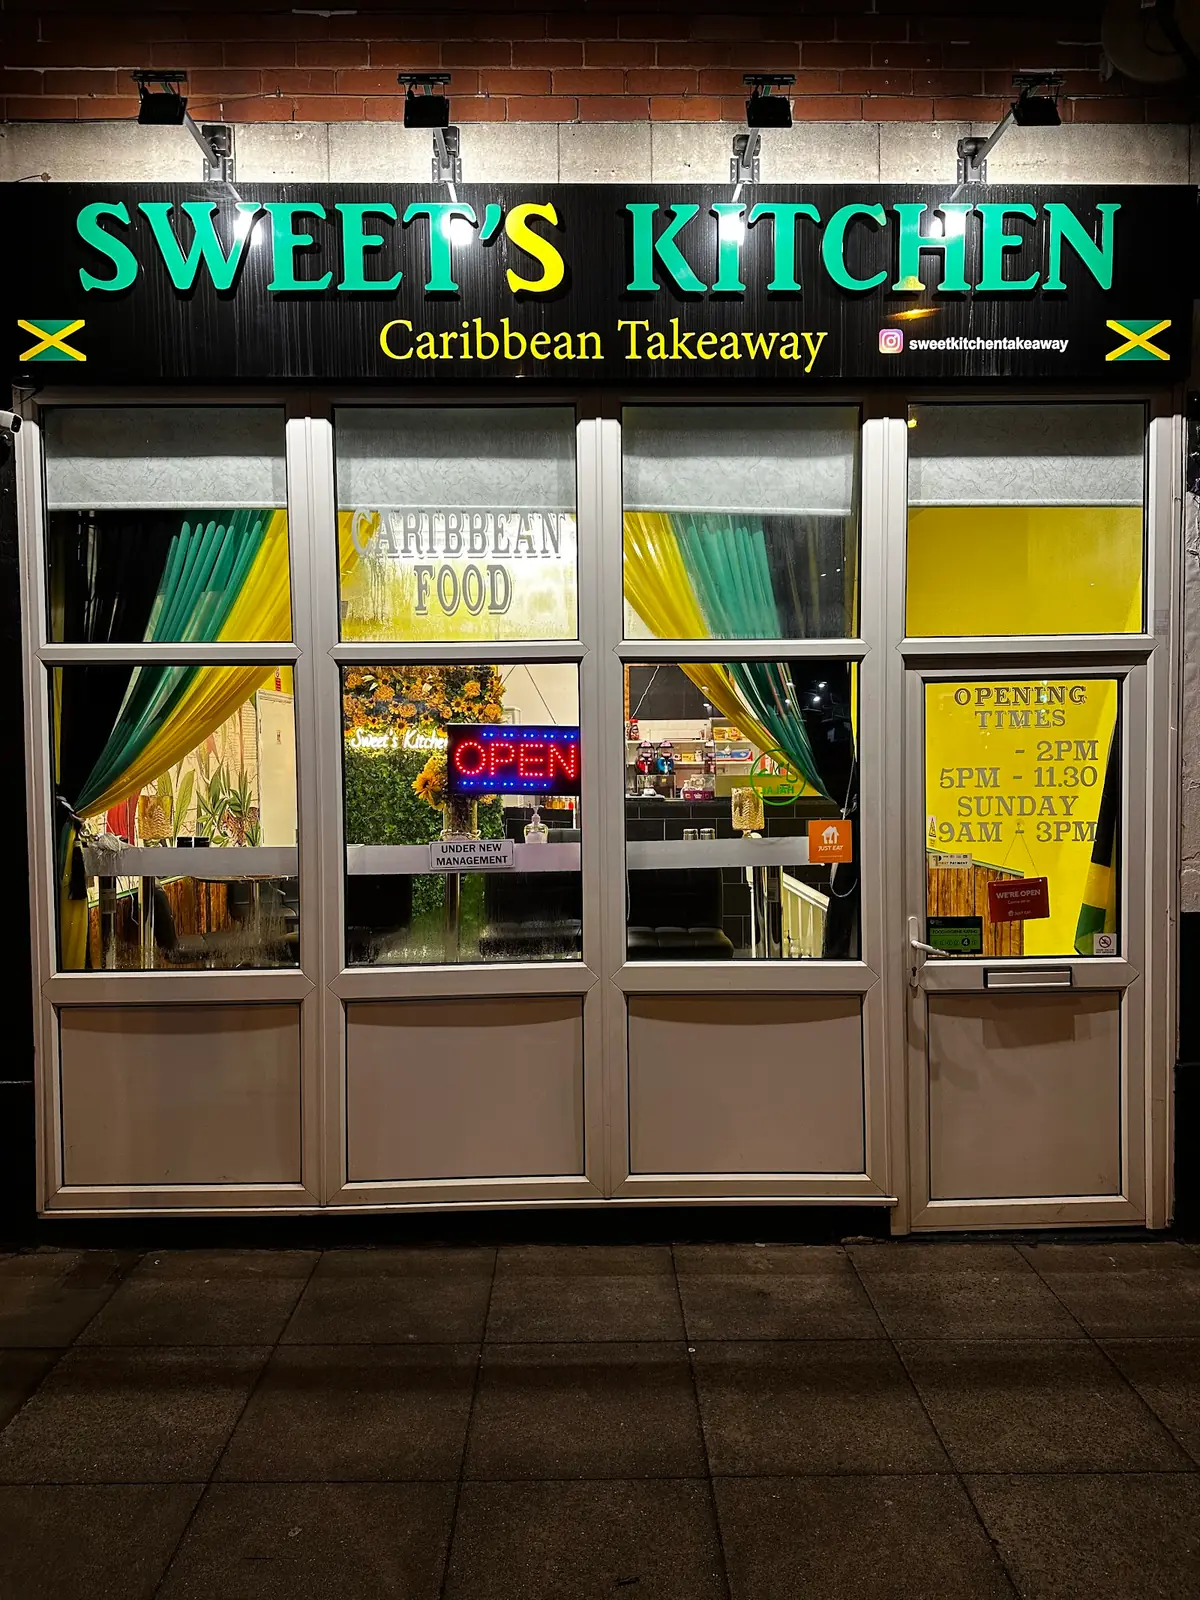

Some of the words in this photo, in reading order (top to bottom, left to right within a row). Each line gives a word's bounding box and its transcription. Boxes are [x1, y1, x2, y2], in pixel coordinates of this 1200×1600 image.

[76, 201, 566, 292] SWEET'S
[626, 203, 1122, 292] KITCHEN
[379, 318, 605, 361] Caribbean
[618, 318, 829, 373] Takeaway
[909, 337, 1069, 353] sweetkitchentakeaway
[352, 507, 566, 558] CARIBBEAN
[414, 564, 512, 616] FOOD
[954, 685, 1088, 707] OPENING
[975, 709, 1066, 729] TIMES
[455, 741, 577, 780] OPEN
[1036, 740, 1099, 762] 2PM
[940, 767, 1001, 789] 5PM
[1034, 765, 1098, 788] 11.30
[957, 795, 1079, 817] SUNDAY
[938, 821, 1003, 843] 9AM
[1036, 821, 1098, 842] 3PM
[441, 845, 476, 854] UNDER
[479, 843, 503, 853] NEW
[436, 855, 508, 866] MANAGEMENT
[1020, 889, 1041, 897] OPEN
